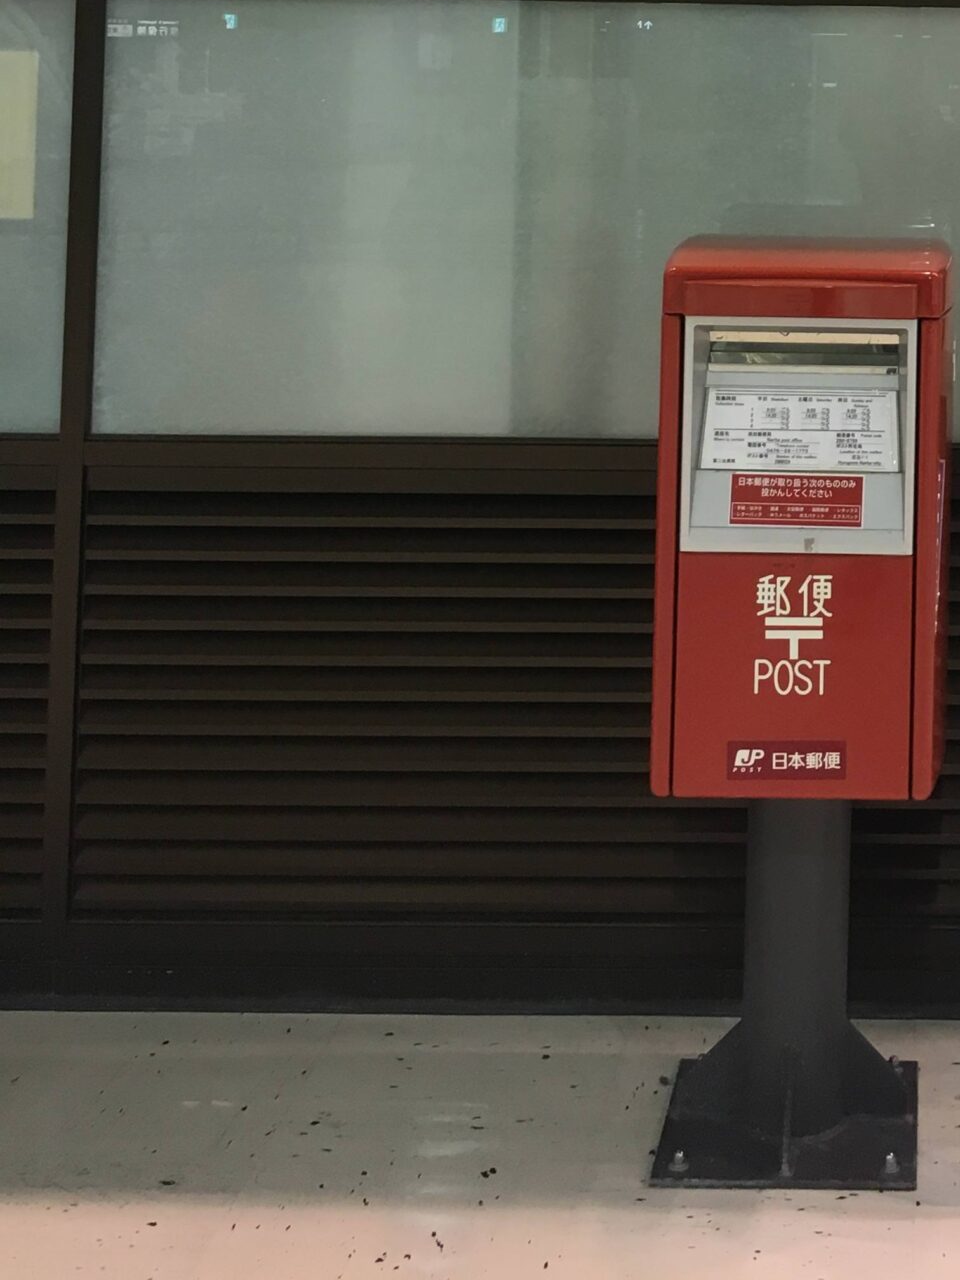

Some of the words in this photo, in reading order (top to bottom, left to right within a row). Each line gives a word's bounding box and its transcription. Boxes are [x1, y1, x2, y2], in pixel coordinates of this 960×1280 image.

[761, 489, 833, 499] 投かんしてください
[756, 574, 833, 617] 郵便
[754, 659, 831, 696] POST
[772, 753, 841, 770] 日本郵便
